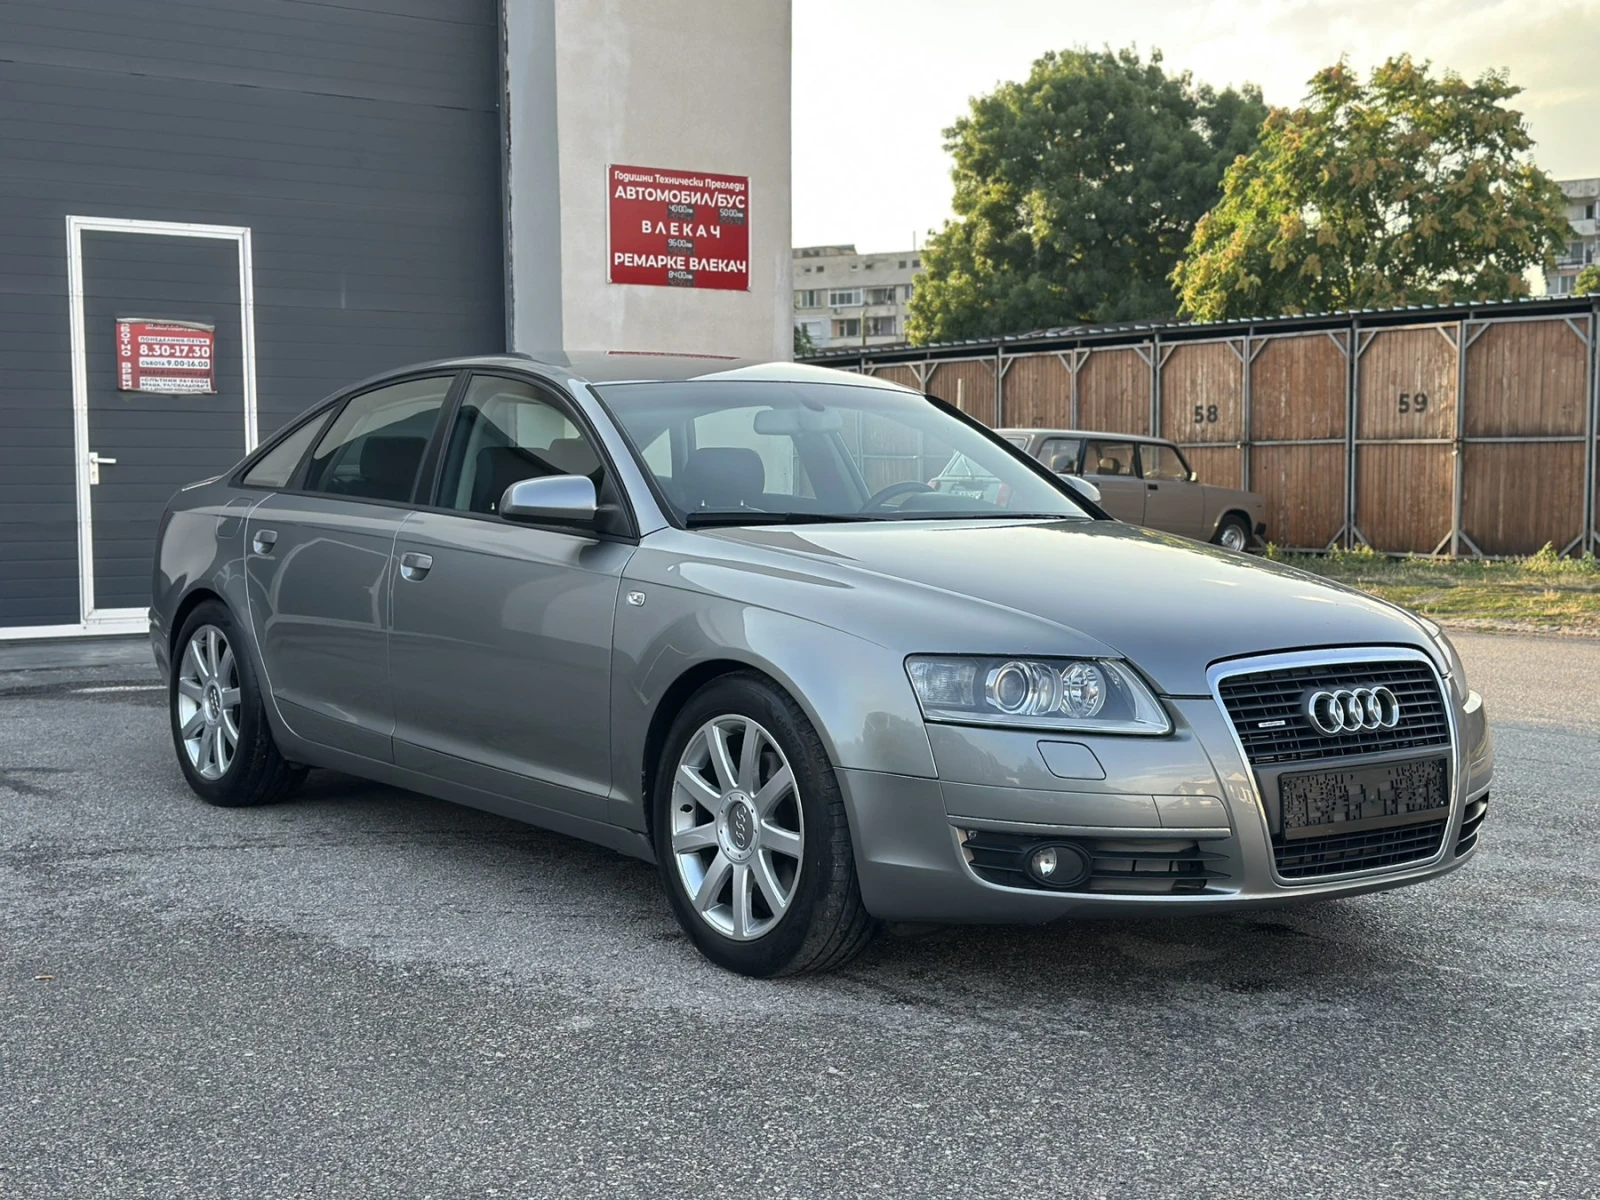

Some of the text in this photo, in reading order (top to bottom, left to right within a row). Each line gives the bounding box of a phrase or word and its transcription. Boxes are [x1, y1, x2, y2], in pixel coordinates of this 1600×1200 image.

[614, 170, 745, 192] Годишни Технически Прегледи
[614, 185, 745, 209] АВТОМОБИЛ/БУС
[614, 252, 746, 274] РЕМАРКЕ ВЛЕКАЧ
[139, 344, 210, 358] 8.30-17.30
[1398, 393, 1428, 414] 59
[1194, 405, 1218, 424] 58
